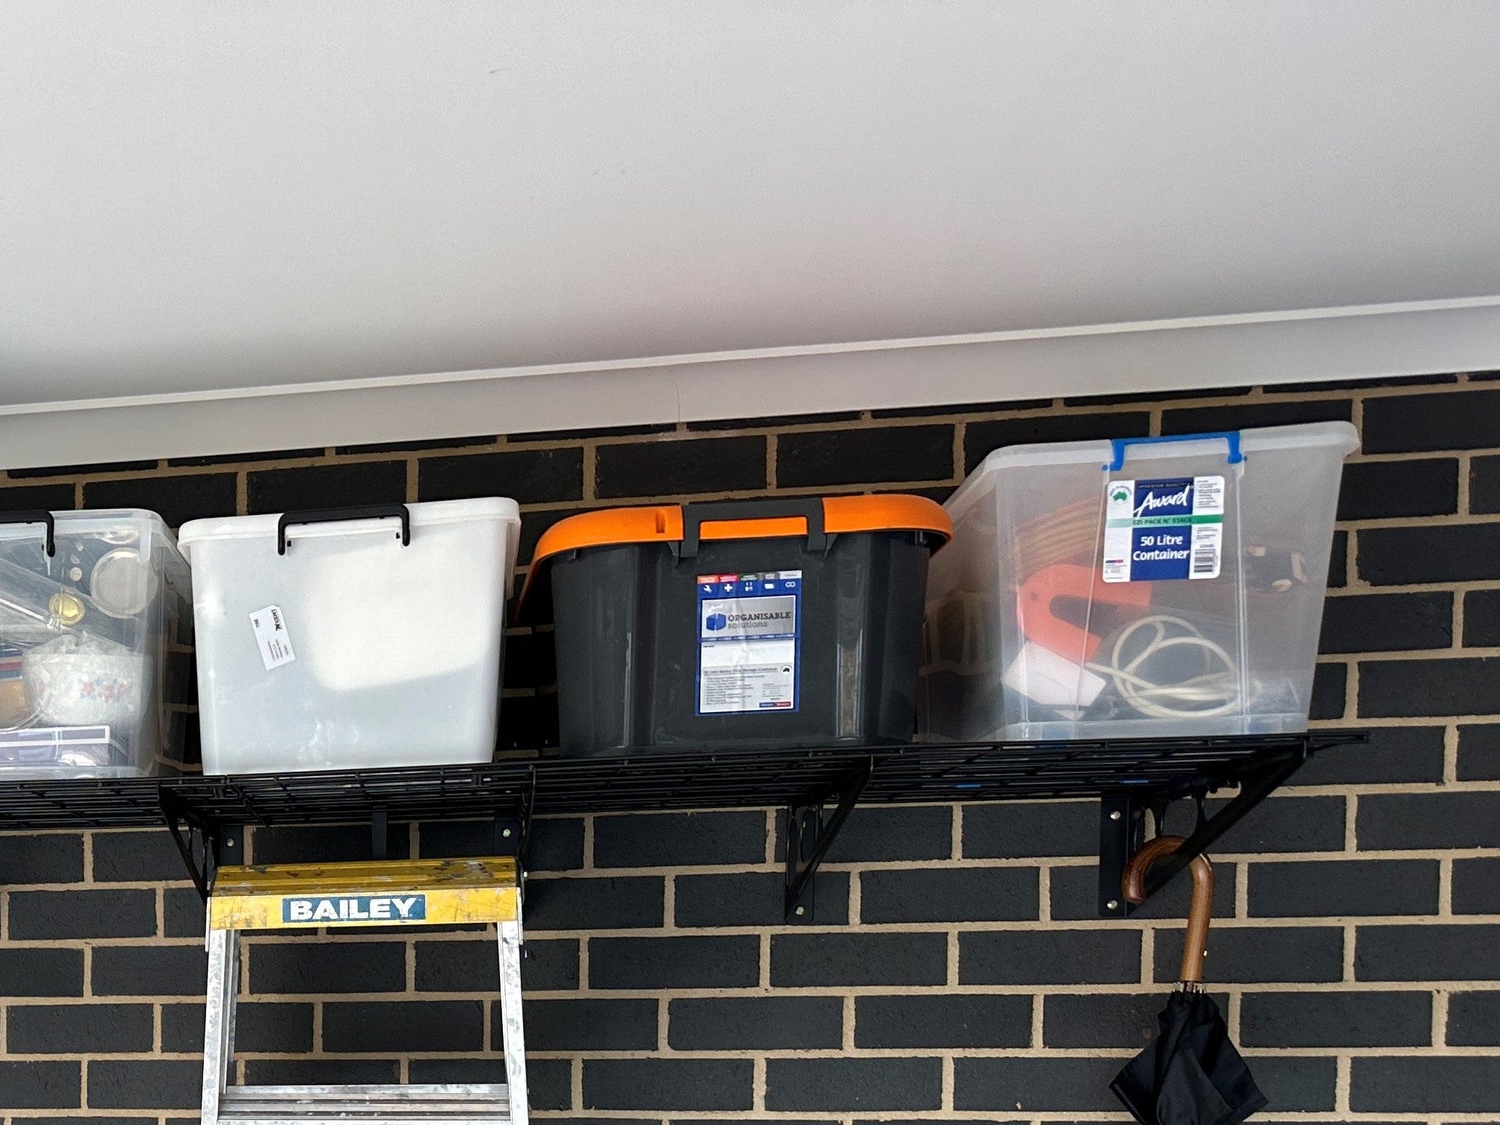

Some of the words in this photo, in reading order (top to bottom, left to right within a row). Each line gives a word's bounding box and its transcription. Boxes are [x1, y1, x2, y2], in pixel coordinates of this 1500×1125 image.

[1133, 485, 1190, 519] Award
[1140, 536, 1154, 546] 50
[1157, 534, 1183, 546] Litre
[1133, 548, 1190, 562] Container
[728, 612, 791, 622] ORGANISABLE
[728, 621, 768, 629] solutions
[290, 898, 417, 920] BAILEY
